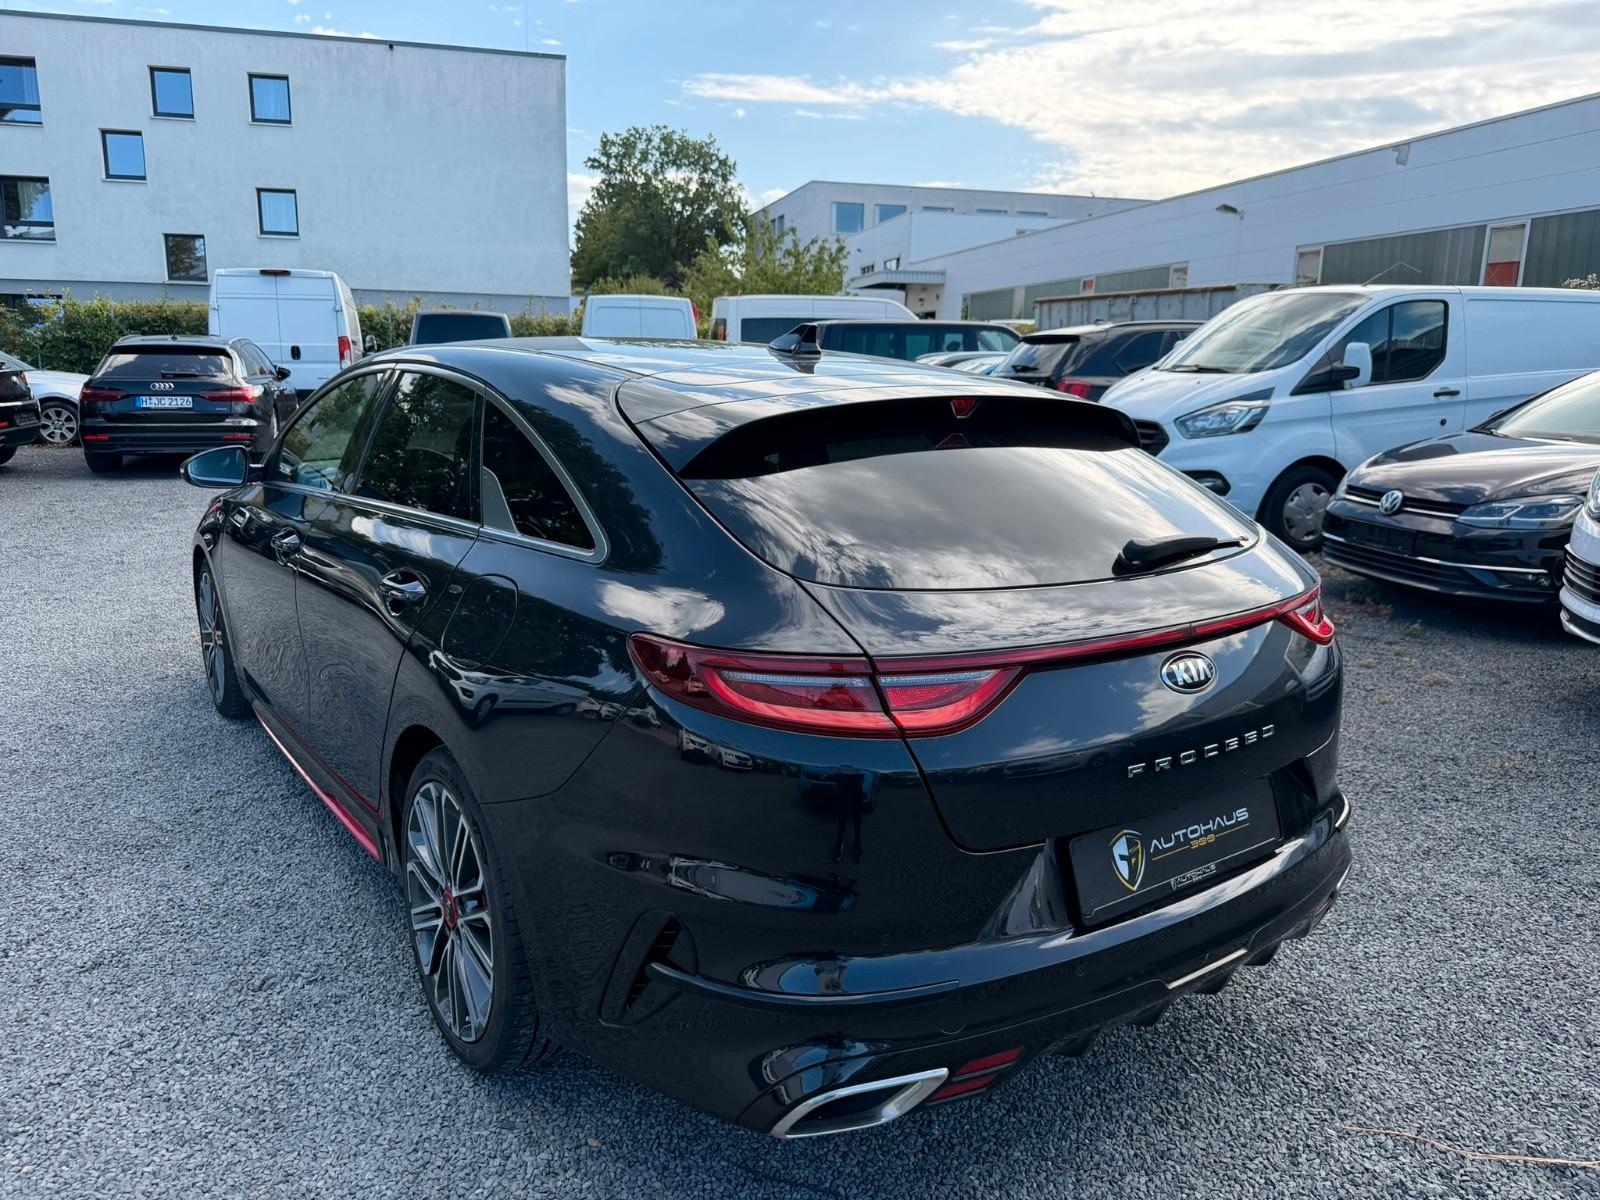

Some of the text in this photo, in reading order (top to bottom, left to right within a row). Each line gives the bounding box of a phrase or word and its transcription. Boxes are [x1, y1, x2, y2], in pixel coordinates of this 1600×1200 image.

[1170, 658, 1212, 686] KIA
[1127, 724, 1275, 778] PROCEED
[1150, 807, 1249, 853] AUTOHAUS
